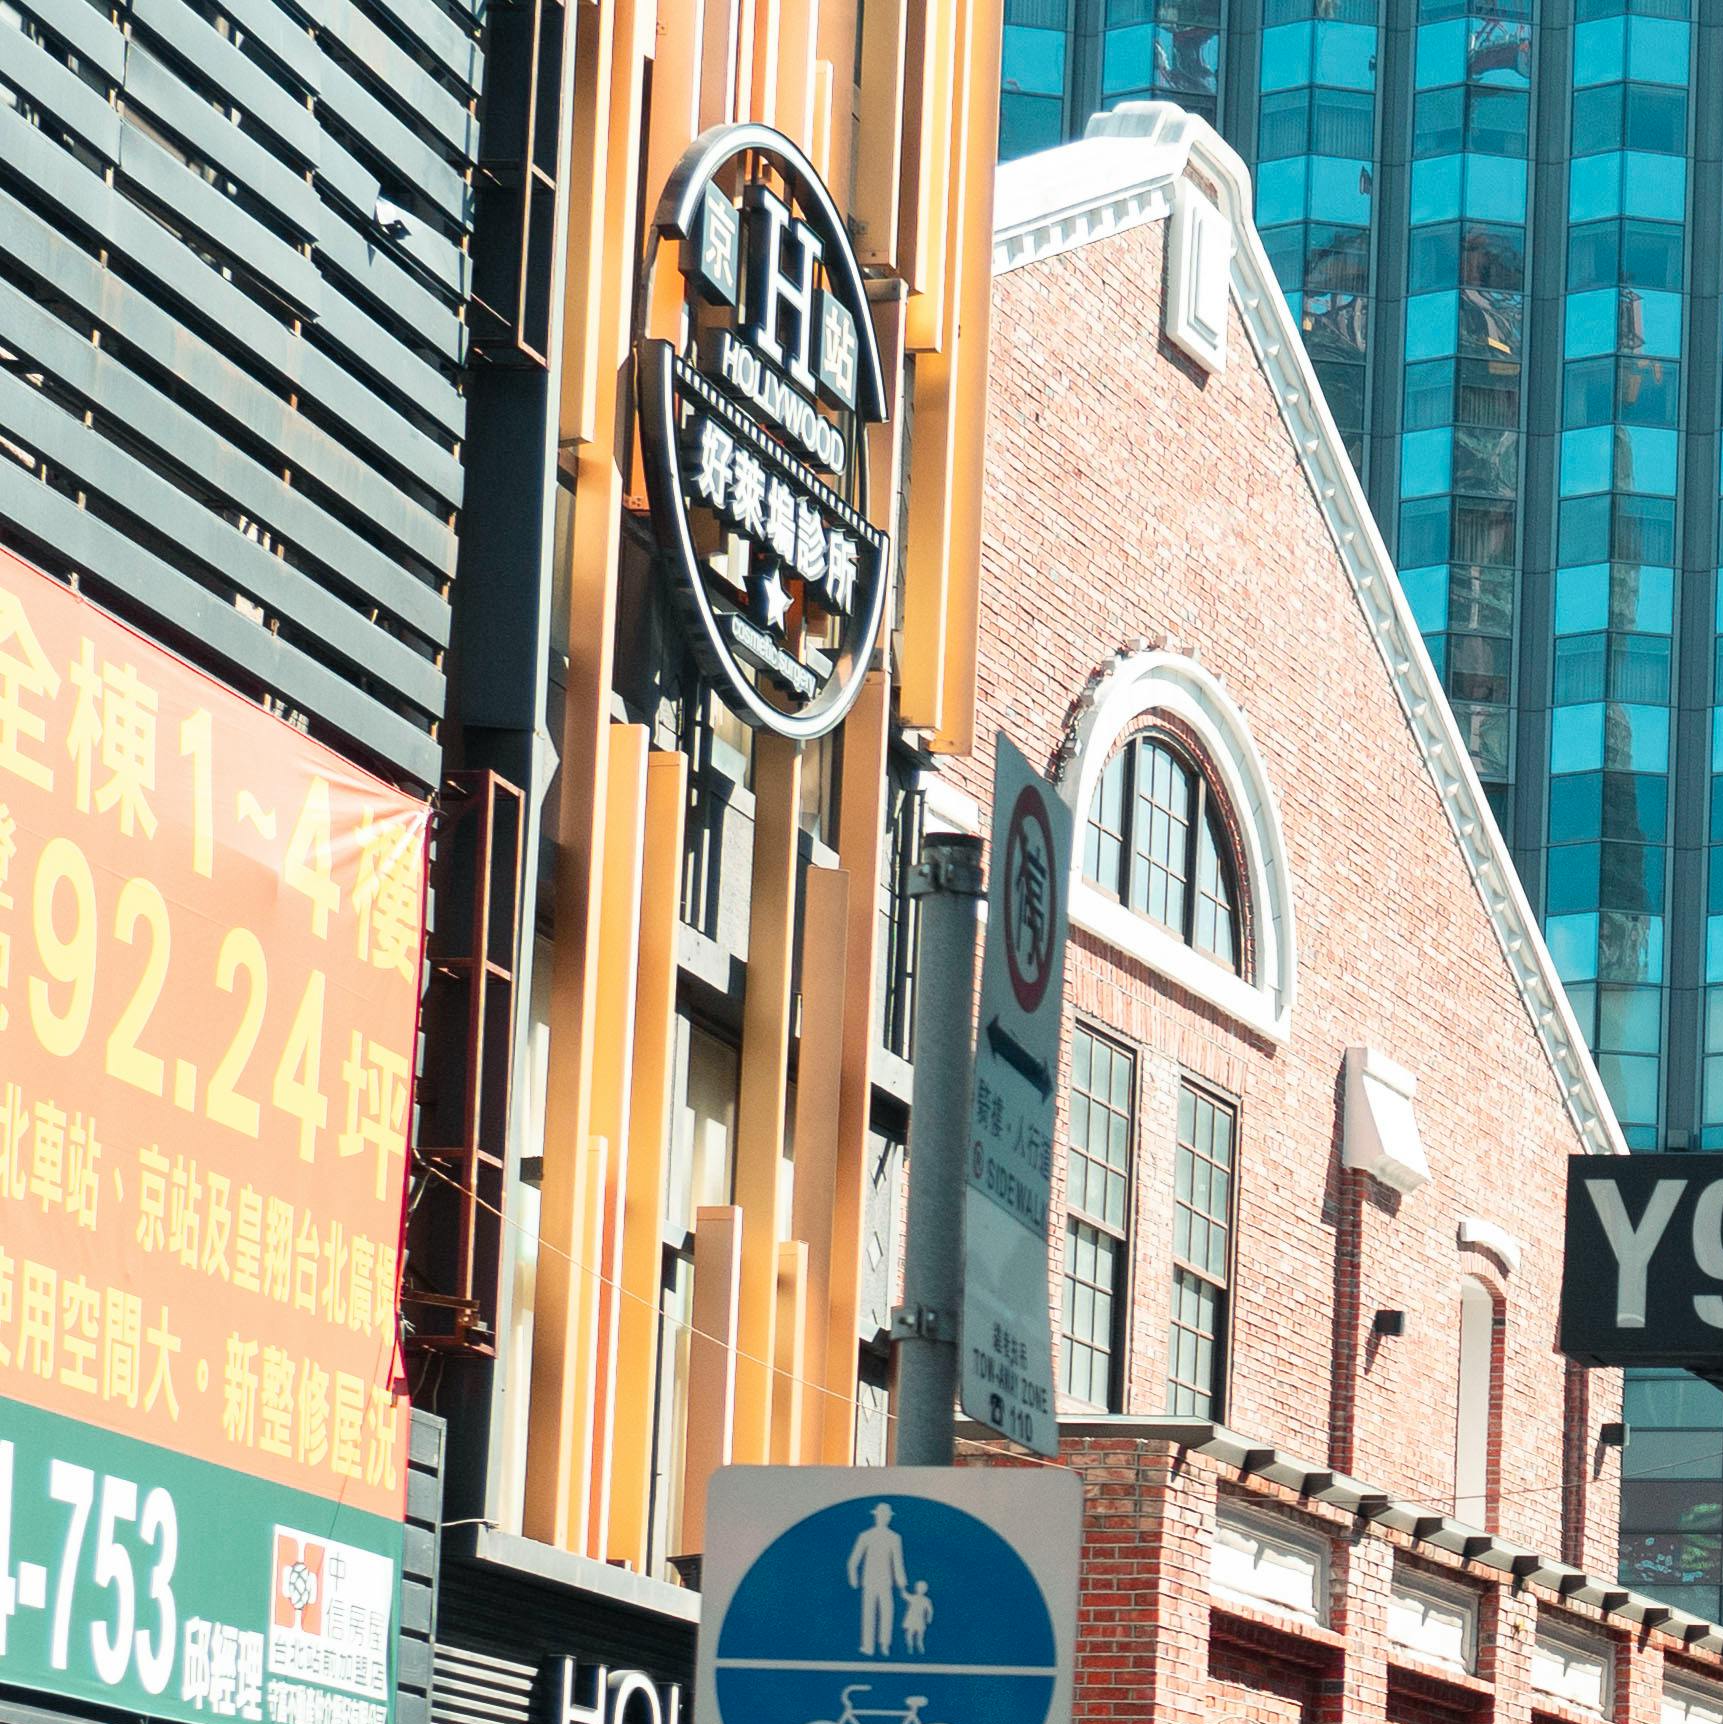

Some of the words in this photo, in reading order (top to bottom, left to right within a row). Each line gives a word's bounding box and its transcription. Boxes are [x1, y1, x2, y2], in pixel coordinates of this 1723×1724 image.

[706, 198, 736, 288] 京
[756, 190, 824, 394] H
[822, 304, 856, 401] 站
[722, 331, 846, 476] HOLLYWOOD
[690, 417, 860, 617] 好萊塢診所
[731, 615, 778, 668] cosmetic
[776, 648, 818, 700] surgery
[1009, 1405, 1033, 1442] 110
[1021, 1376, 1048, 1415] ZONE
[329, 1551, 345, 1592] 中
[182, 1615, 265, 1722] 邱經理
